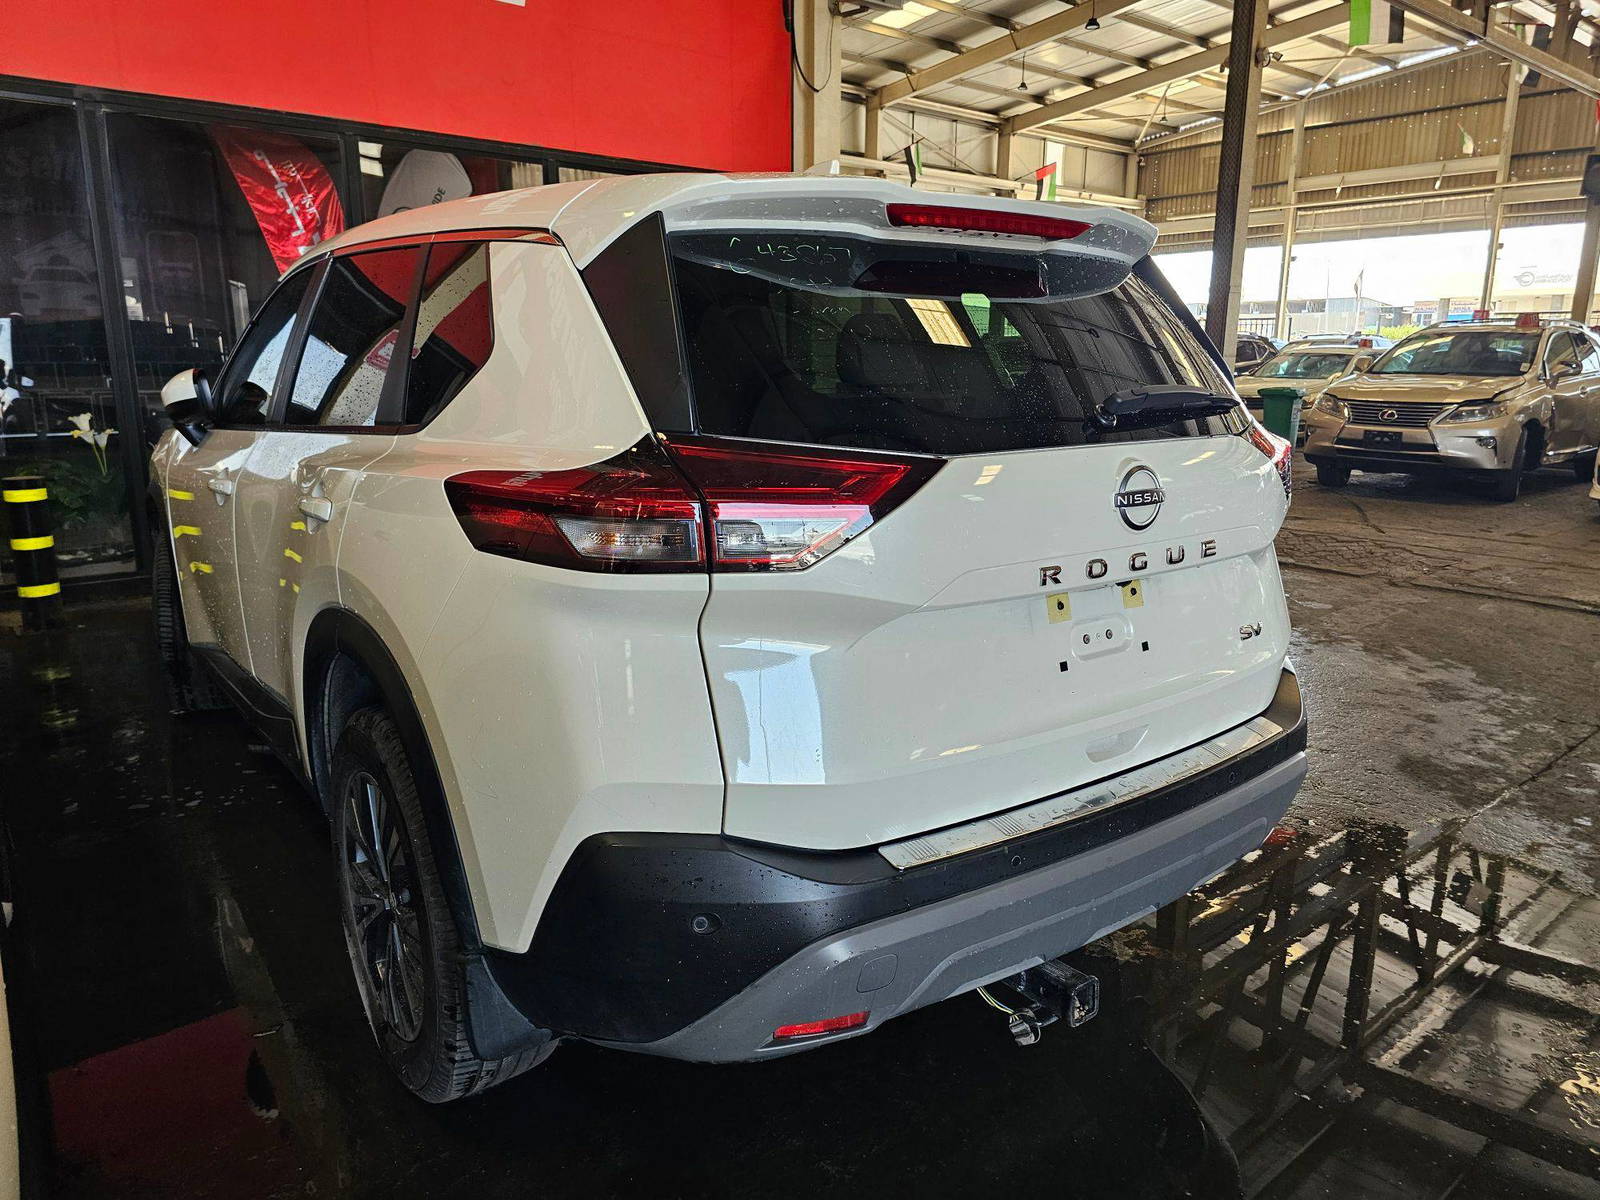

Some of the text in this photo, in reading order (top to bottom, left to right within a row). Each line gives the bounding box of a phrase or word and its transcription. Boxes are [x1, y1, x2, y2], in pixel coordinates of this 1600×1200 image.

[1117, 491, 1165, 506] NISSAN
[1039, 539, 1217, 587] ROGUE
[1239, 621, 1262, 641] SV
